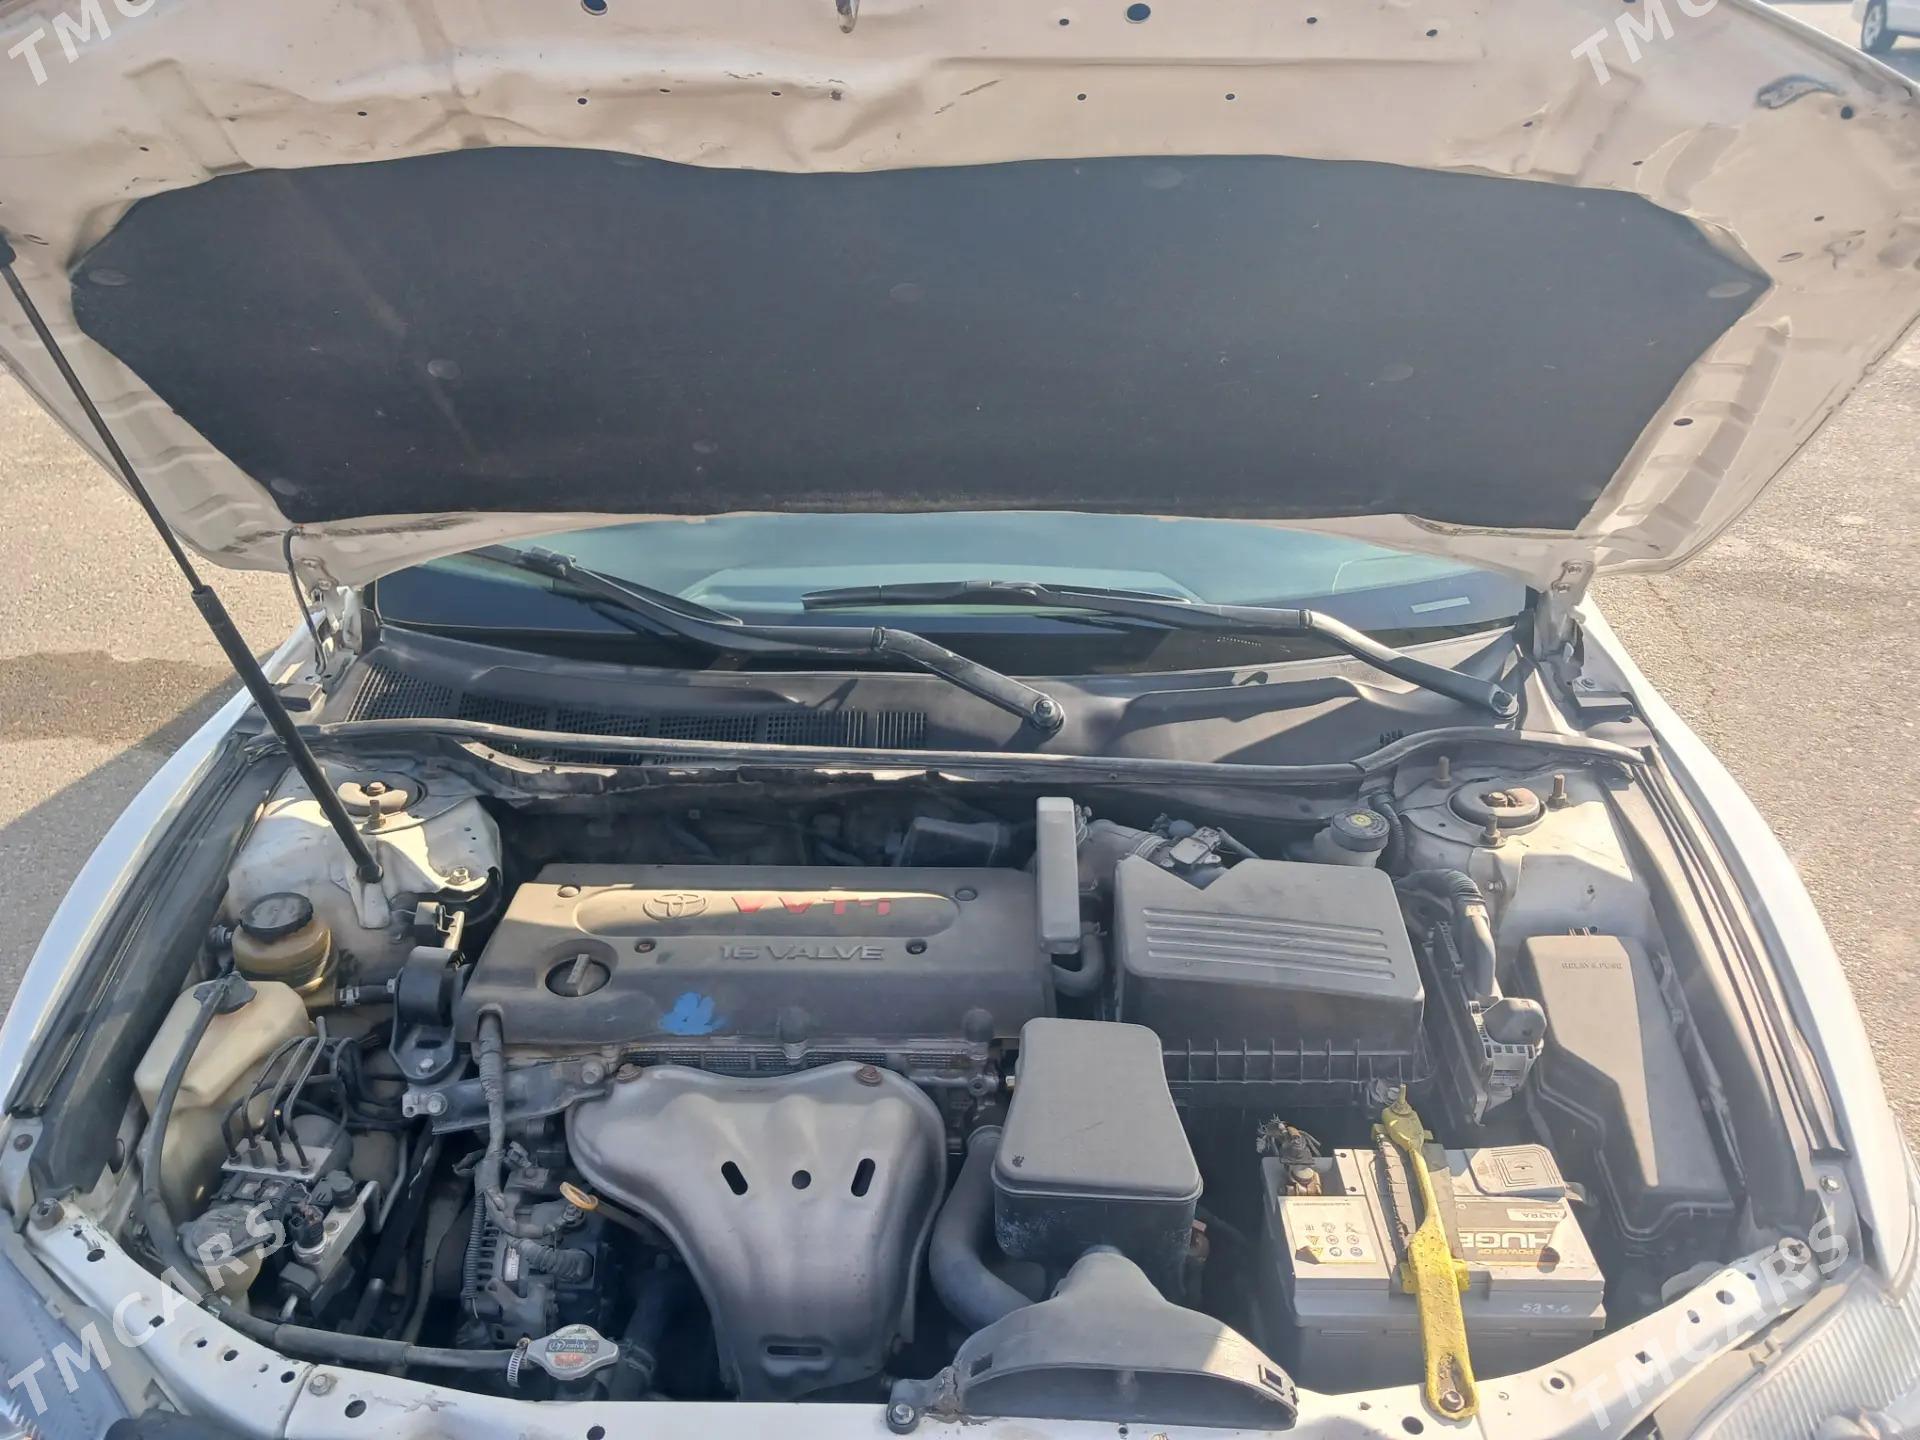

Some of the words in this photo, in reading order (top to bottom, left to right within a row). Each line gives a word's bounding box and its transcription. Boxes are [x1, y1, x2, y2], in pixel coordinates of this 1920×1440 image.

[720, 945, 760, 960] 16
[766, 944, 885, 960] VALVE
[1458, 1231, 1552, 1249] HUGE
